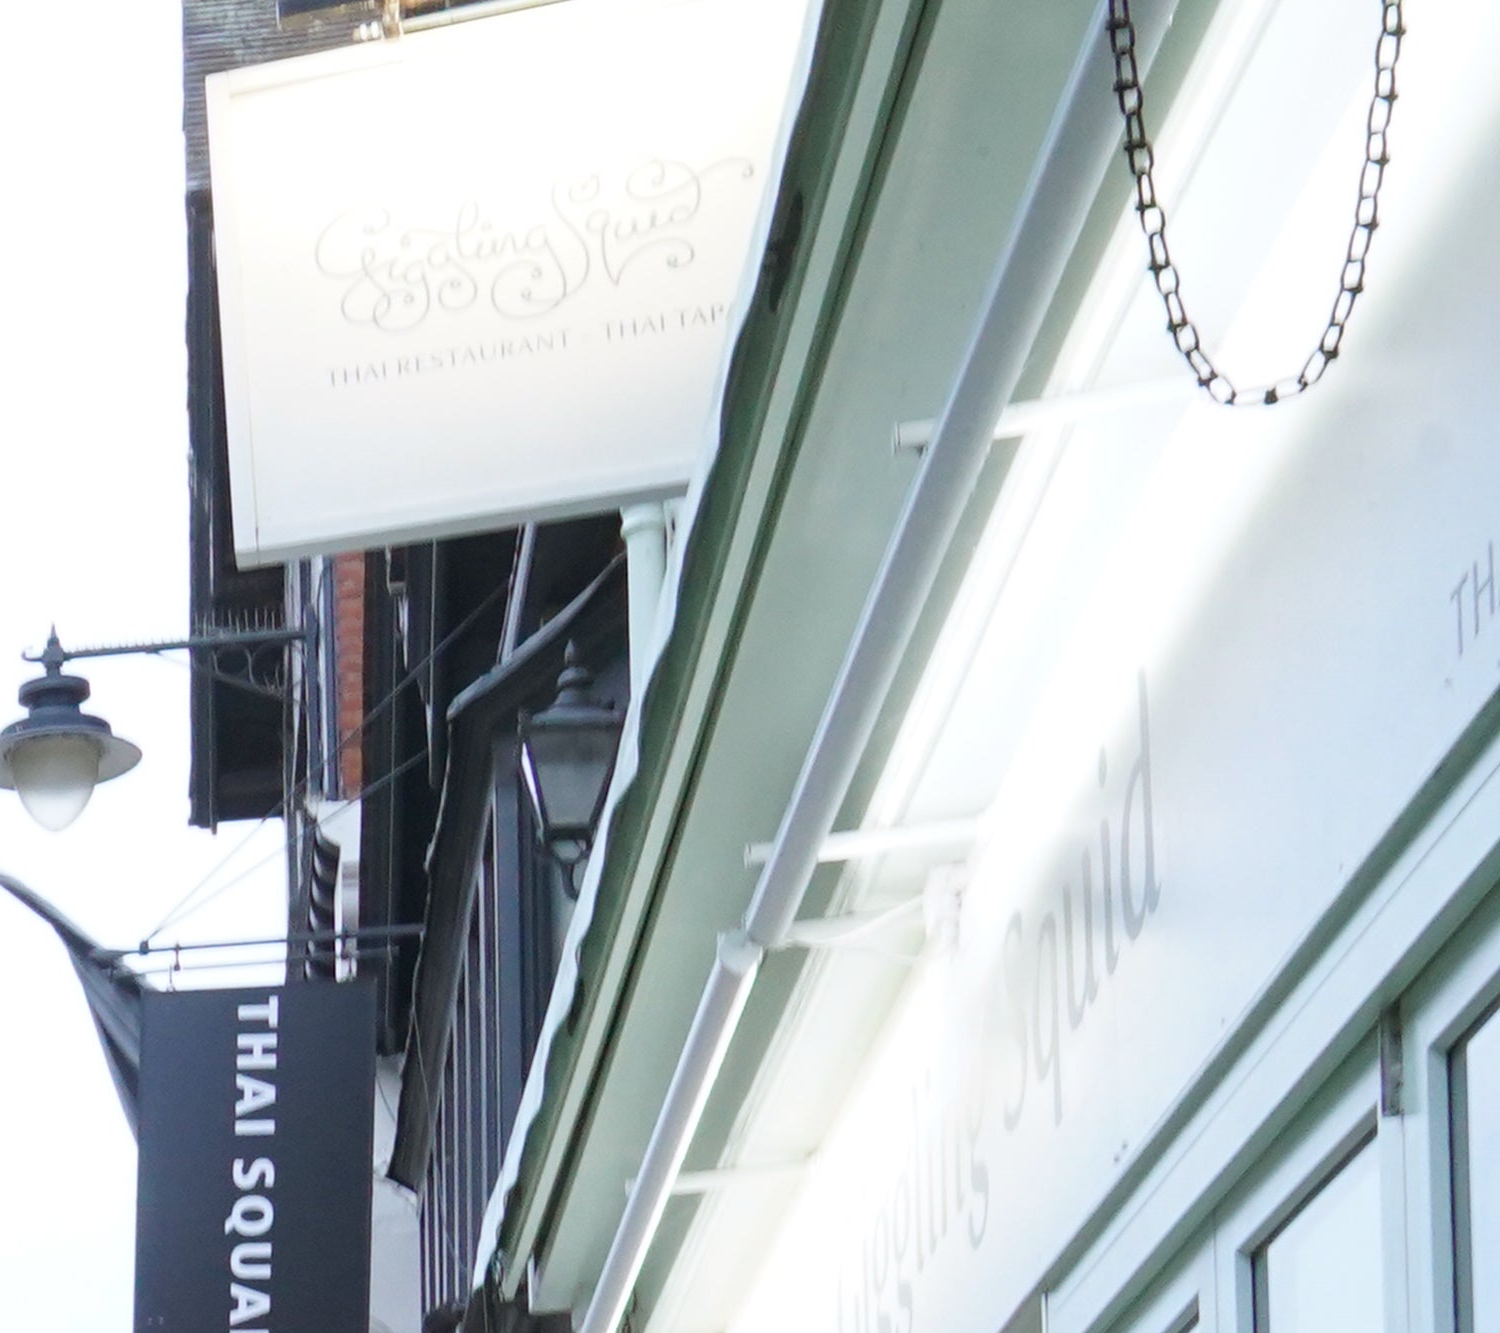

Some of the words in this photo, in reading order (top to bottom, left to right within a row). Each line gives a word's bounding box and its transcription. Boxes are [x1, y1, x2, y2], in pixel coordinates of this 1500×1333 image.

[314, 200, 567, 332] Giggling
[528, 156, 754, 302] Squid
[325, 360, 389, 388] THAI
[397, 329, 573, 378] RESTAURANT
[601, 312, 667, 343] THAI
[675, 302, 731, 330] TAP
[1450, 540, 1500, 657] TH
[1001, 666, 1164, 1131] Squid
[234, 994, 281, 1137] THAI
